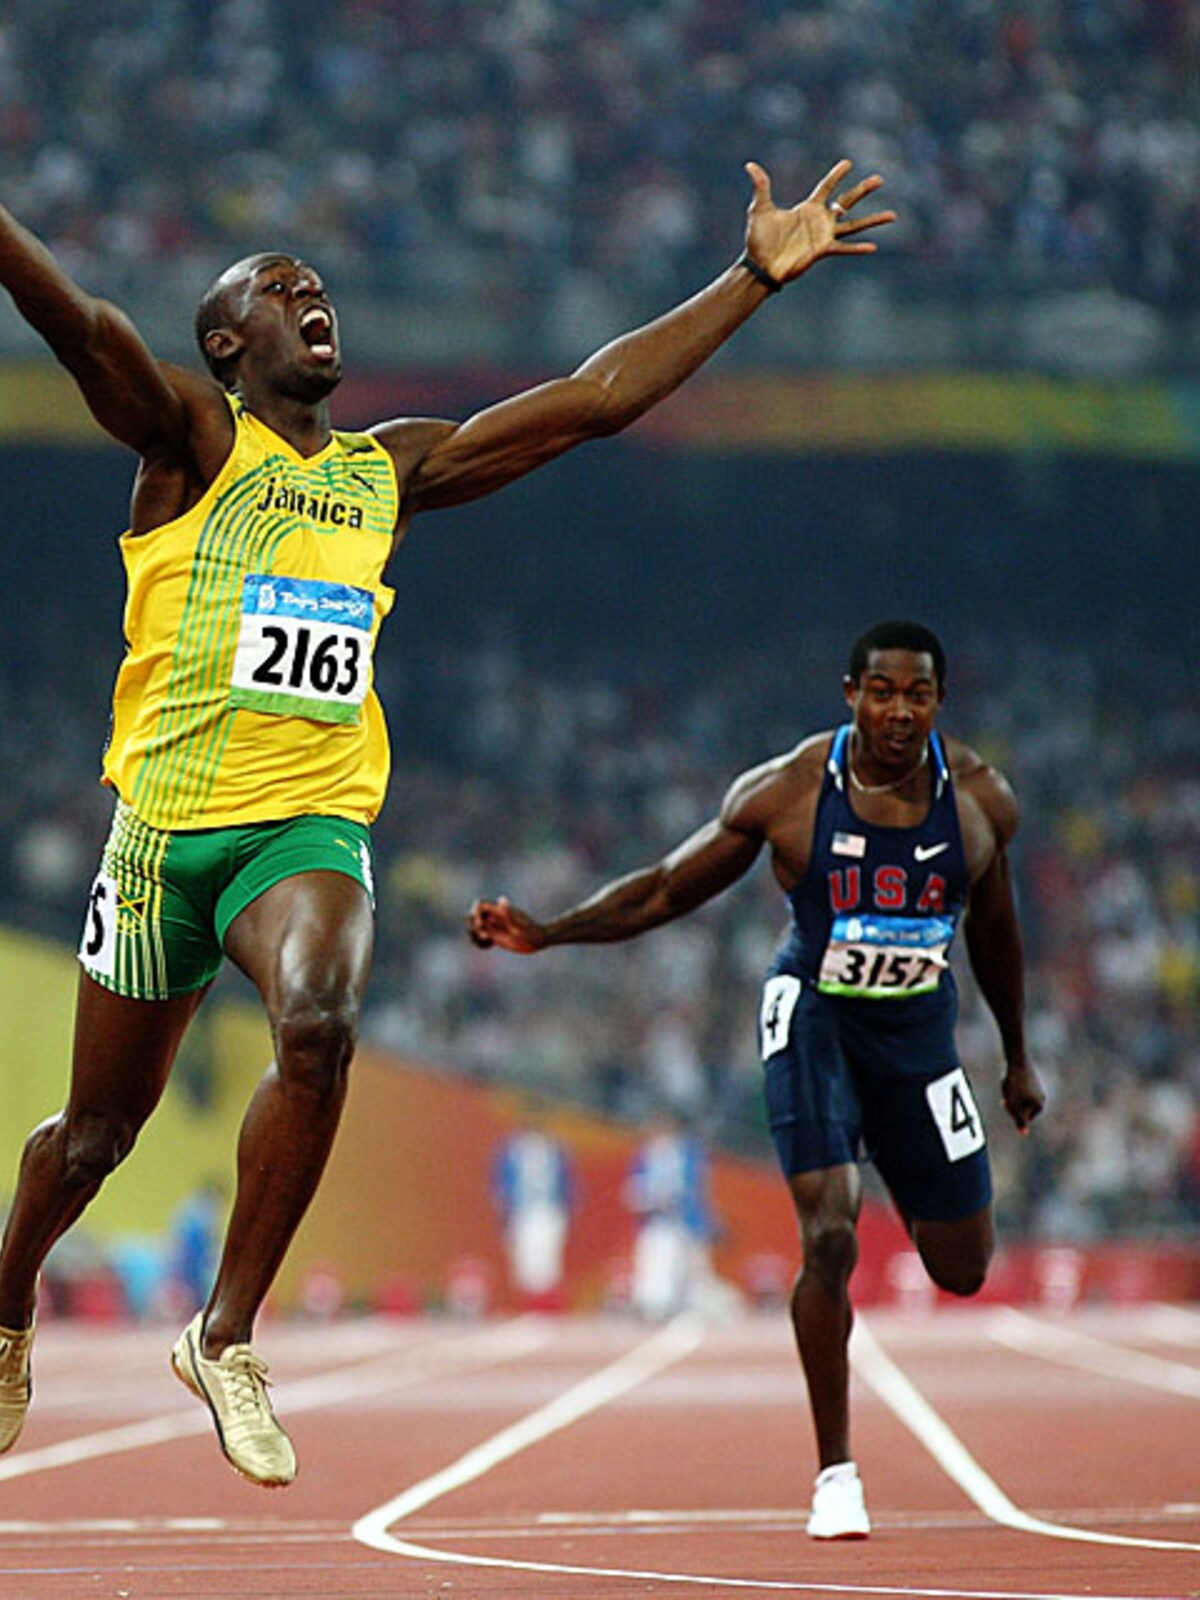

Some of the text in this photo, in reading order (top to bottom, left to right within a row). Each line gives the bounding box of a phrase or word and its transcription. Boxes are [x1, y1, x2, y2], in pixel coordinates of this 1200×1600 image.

[252, 626, 360, 696] 2163
[828, 864, 945, 913] USA
[766, 988, 786, 1041] 4
[950, 1082, 977, 1140] 4
